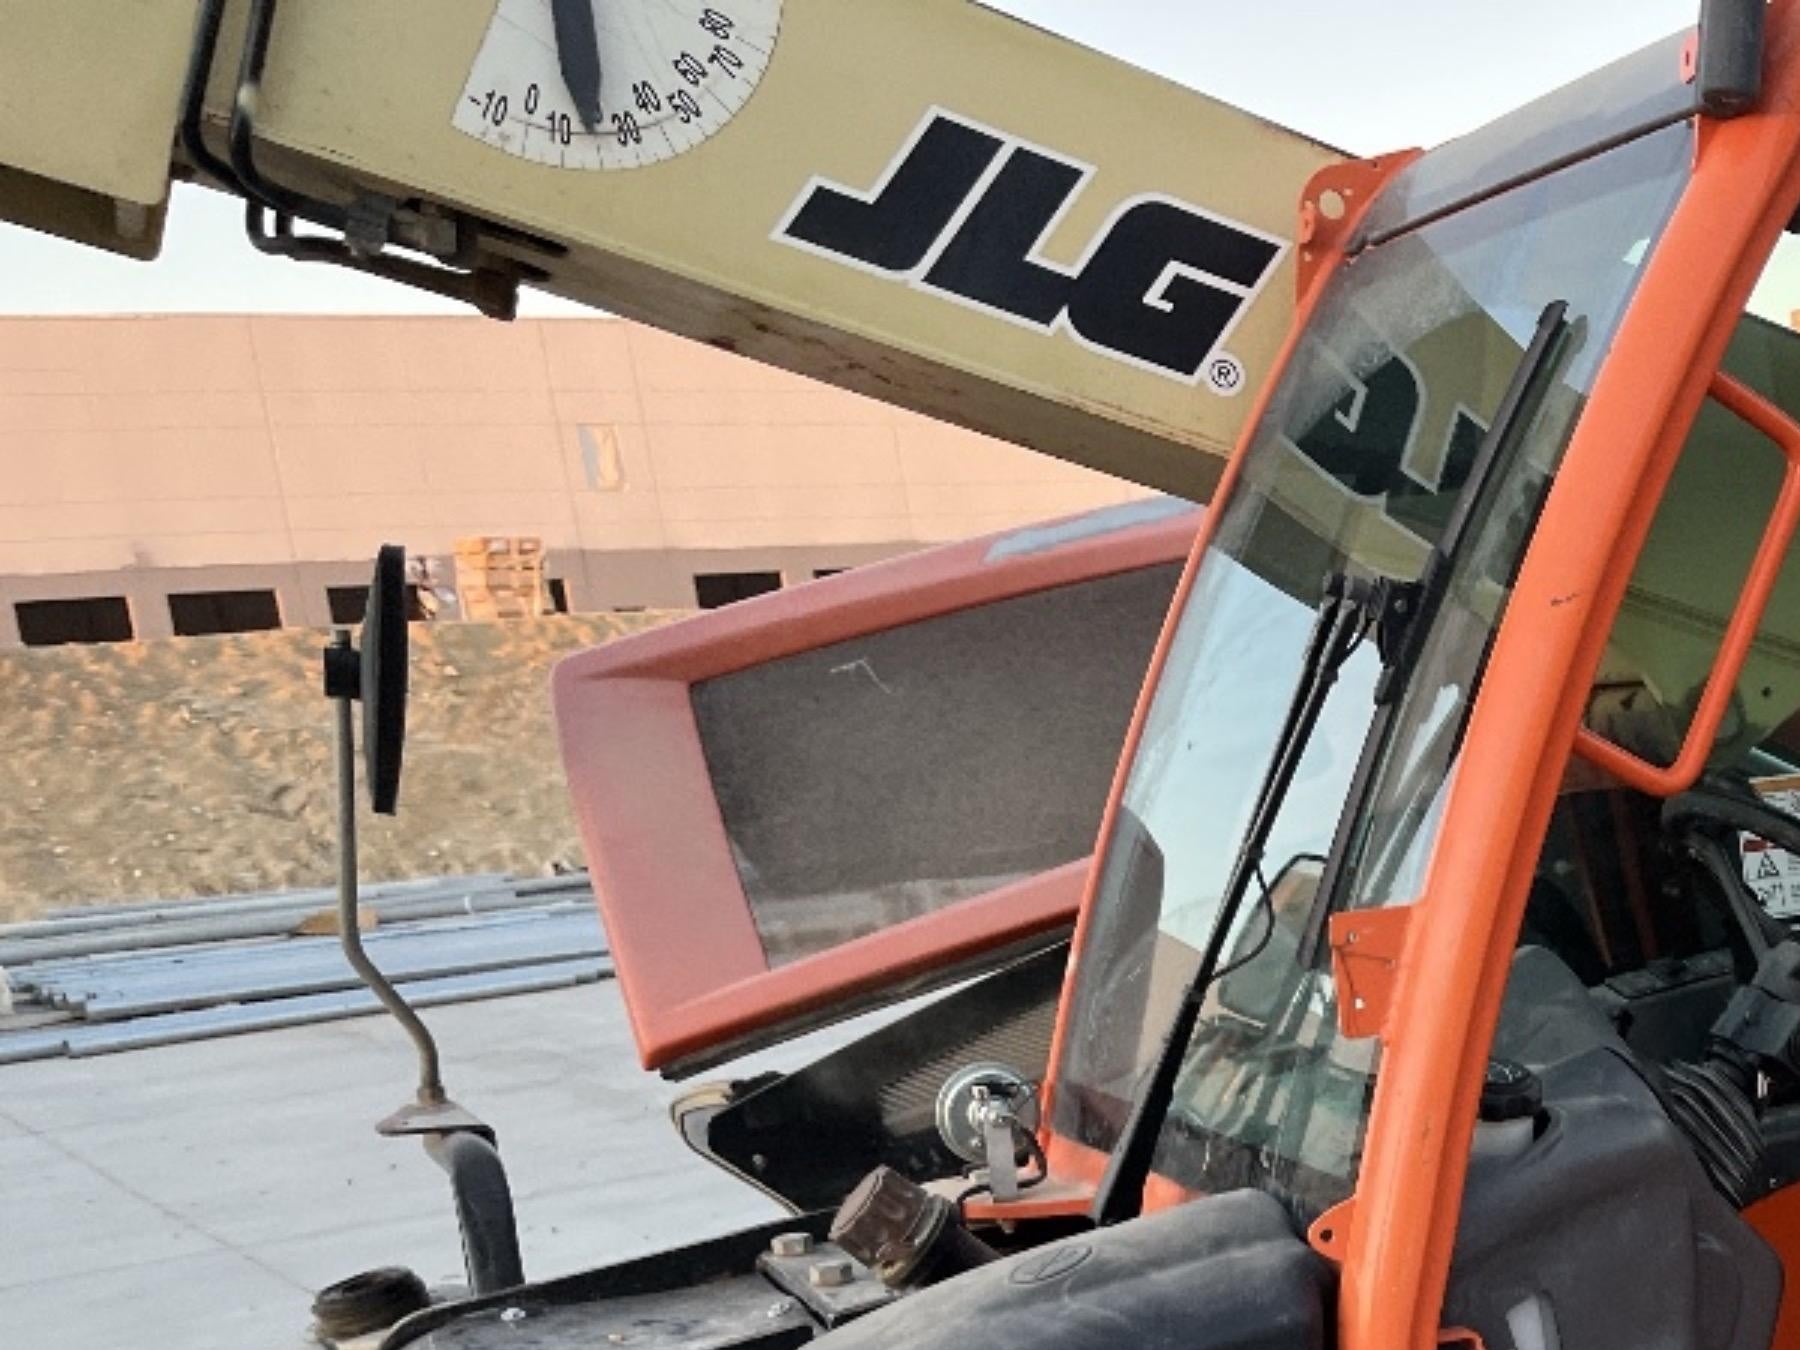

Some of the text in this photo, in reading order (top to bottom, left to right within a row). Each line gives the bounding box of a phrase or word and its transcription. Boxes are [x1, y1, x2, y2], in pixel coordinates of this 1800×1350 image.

[468, 89, 508, 126] -10
[525, 83, 538, 115] 0
[545, 110, 571, 145] 10
[611, 110, 642, 147] 30
[632, 80, 661, 115] 40
[666, 88, 702, 124] 50
[707, 44, 744, 79] 70
[772, 106, 1290, 384] JLG
